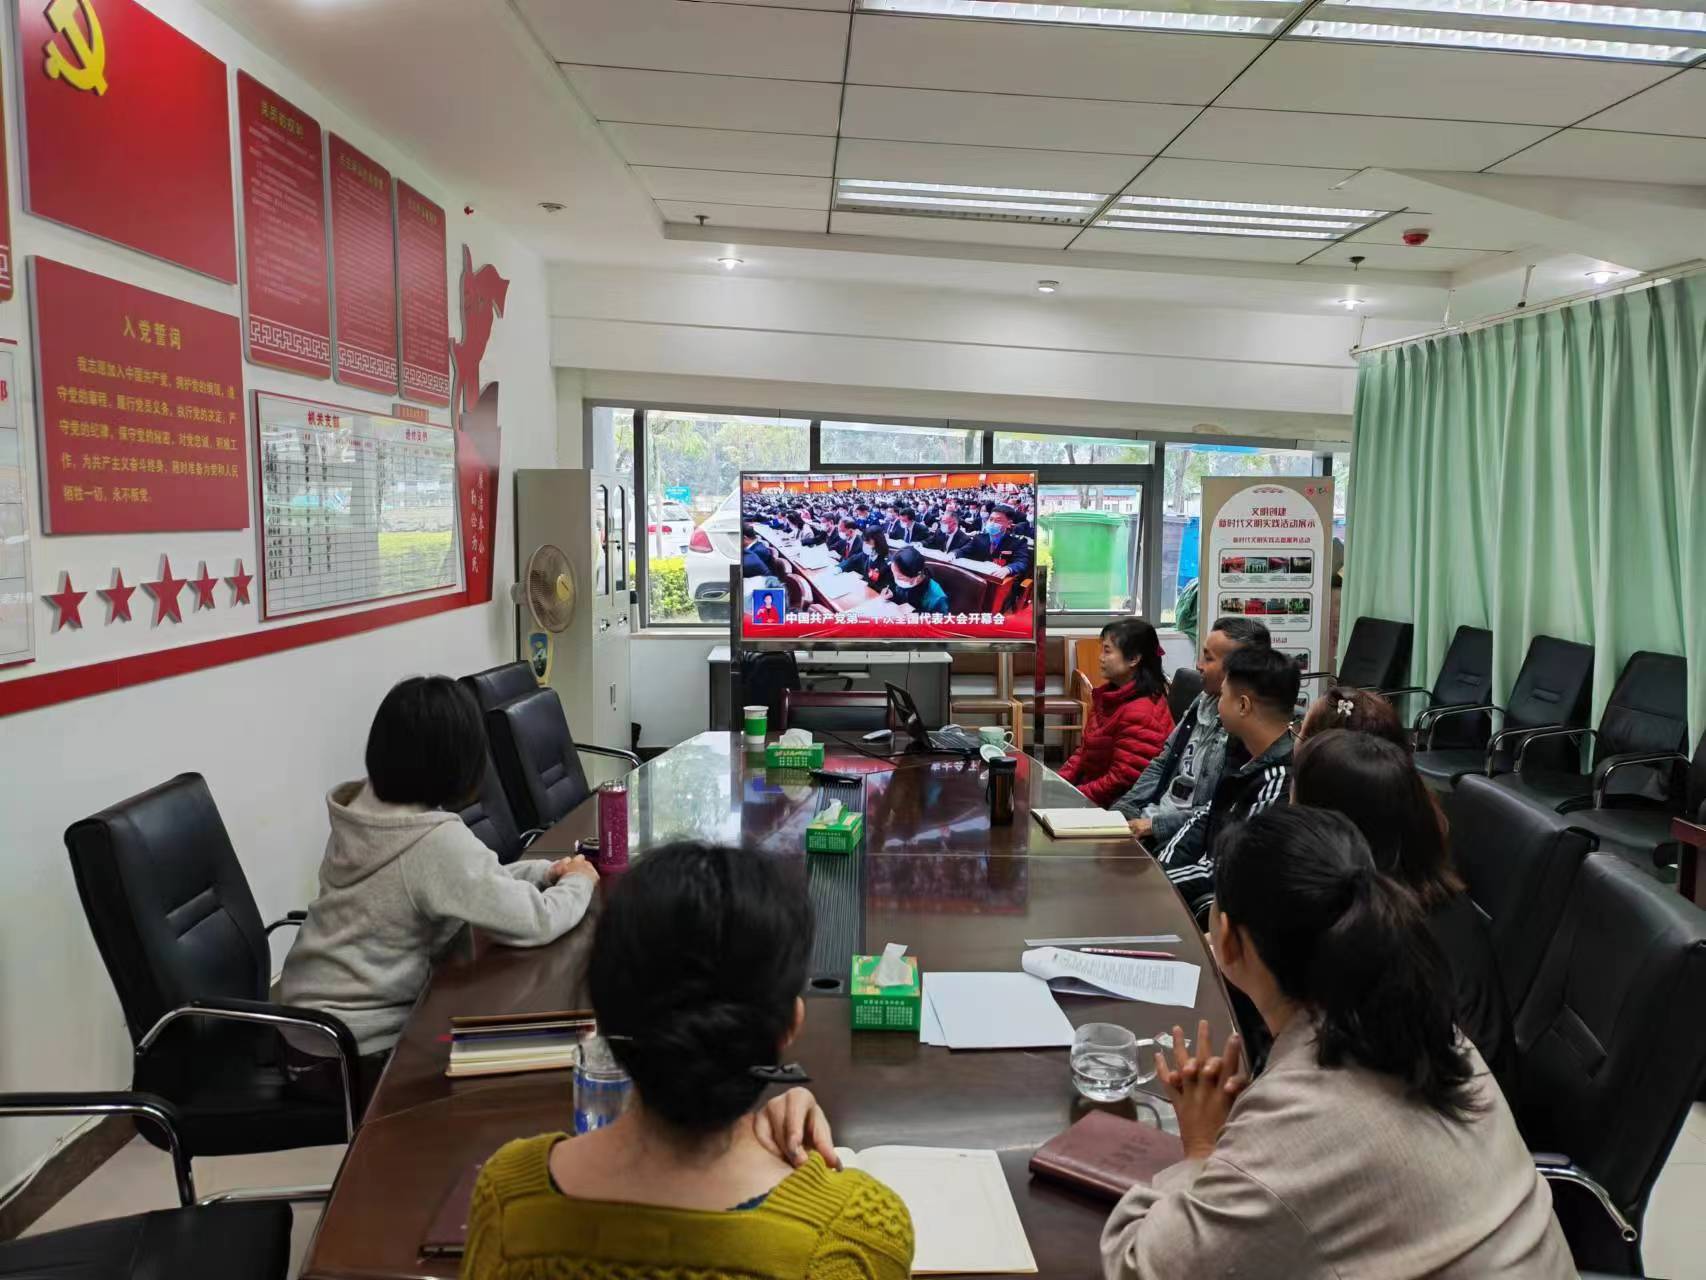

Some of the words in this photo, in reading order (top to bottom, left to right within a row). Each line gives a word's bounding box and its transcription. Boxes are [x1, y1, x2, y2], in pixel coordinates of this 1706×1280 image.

[123, 315, 181, 350] 入党誓词
[1251, 507, 1286, 516] 文明创建
[1218, 519, 1315, 528] 新时代文明实践活动展示
[785, 612, 1006, 625] 中国共产党第二十次全国代表大会开幕会
